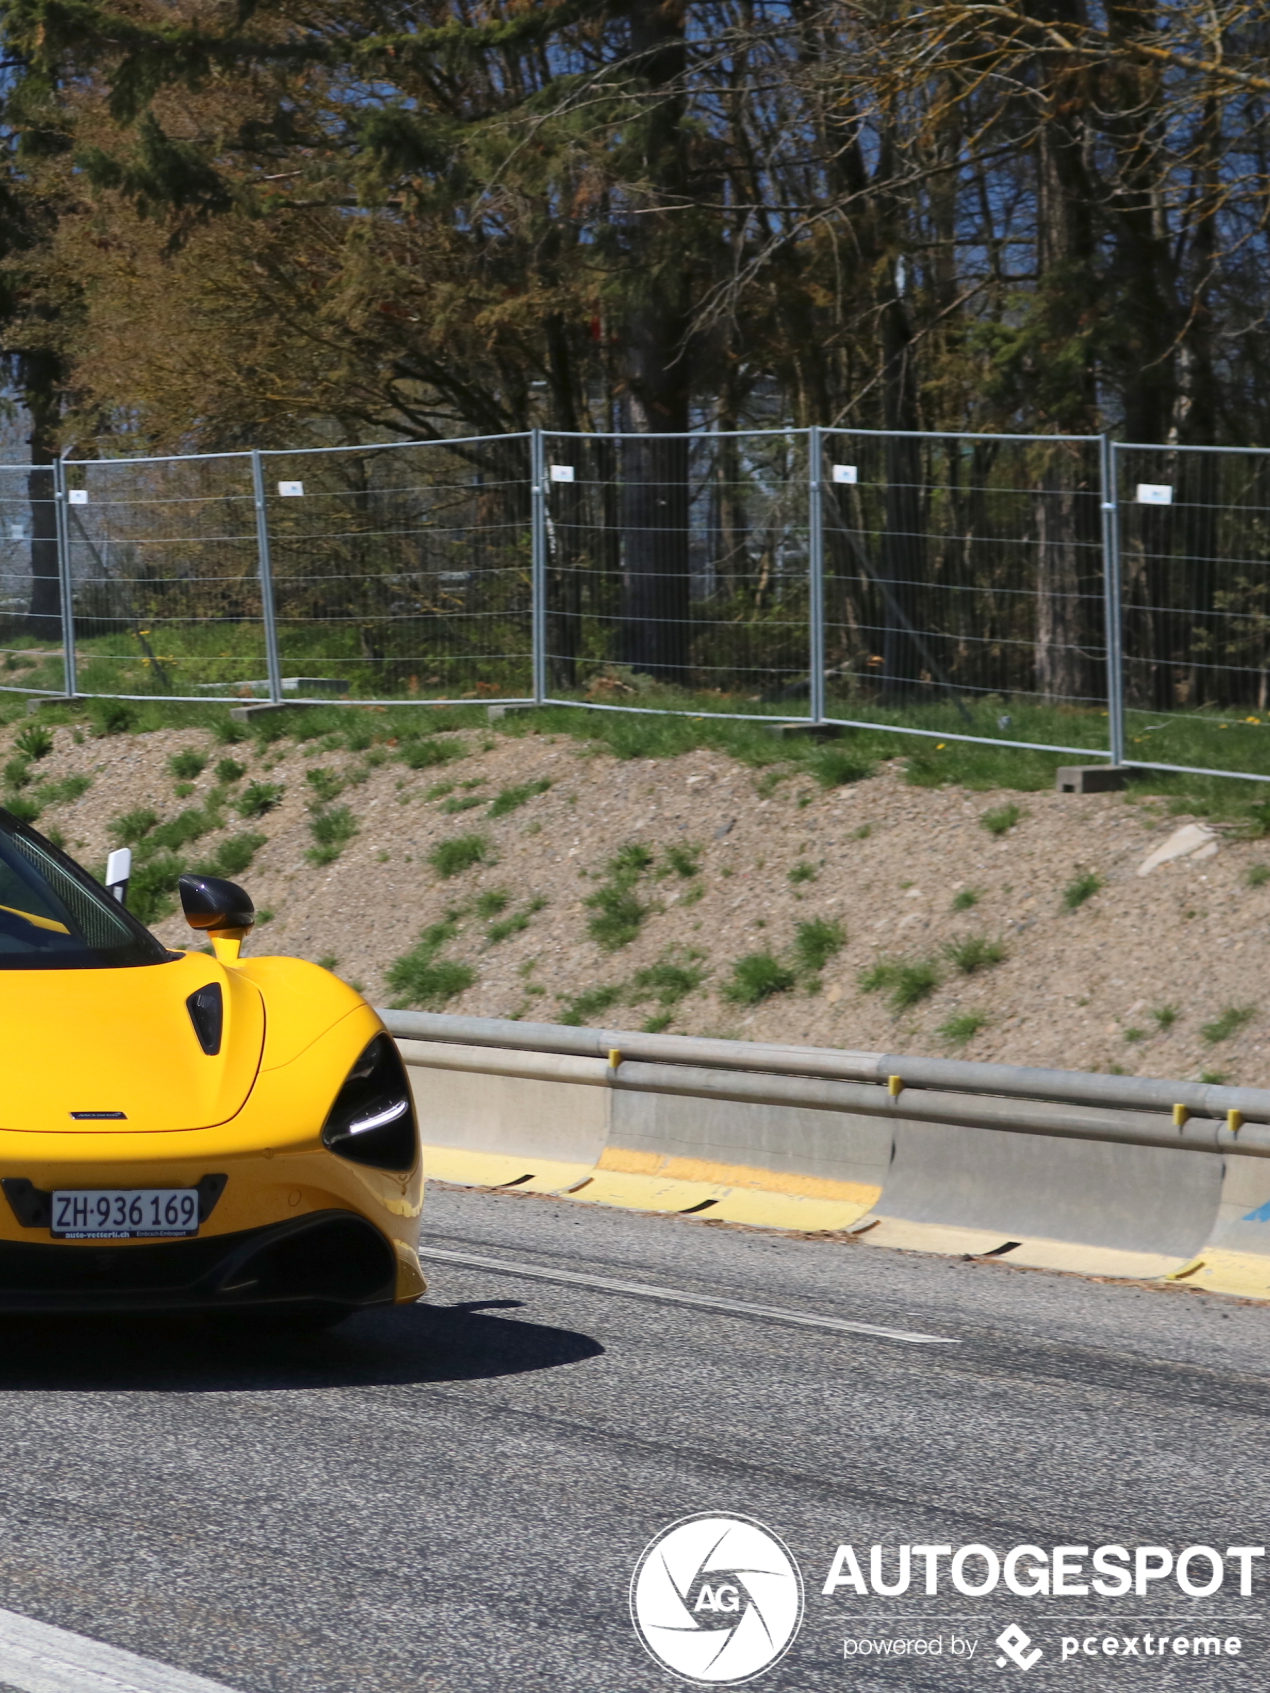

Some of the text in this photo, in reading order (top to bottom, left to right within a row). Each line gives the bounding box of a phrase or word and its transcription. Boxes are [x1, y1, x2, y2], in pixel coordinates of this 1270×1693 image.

[150, 1194, 195, 1226] 169
[65, 1230, 186, 1239] auto-vetterli.ch Embrach-Embraport
